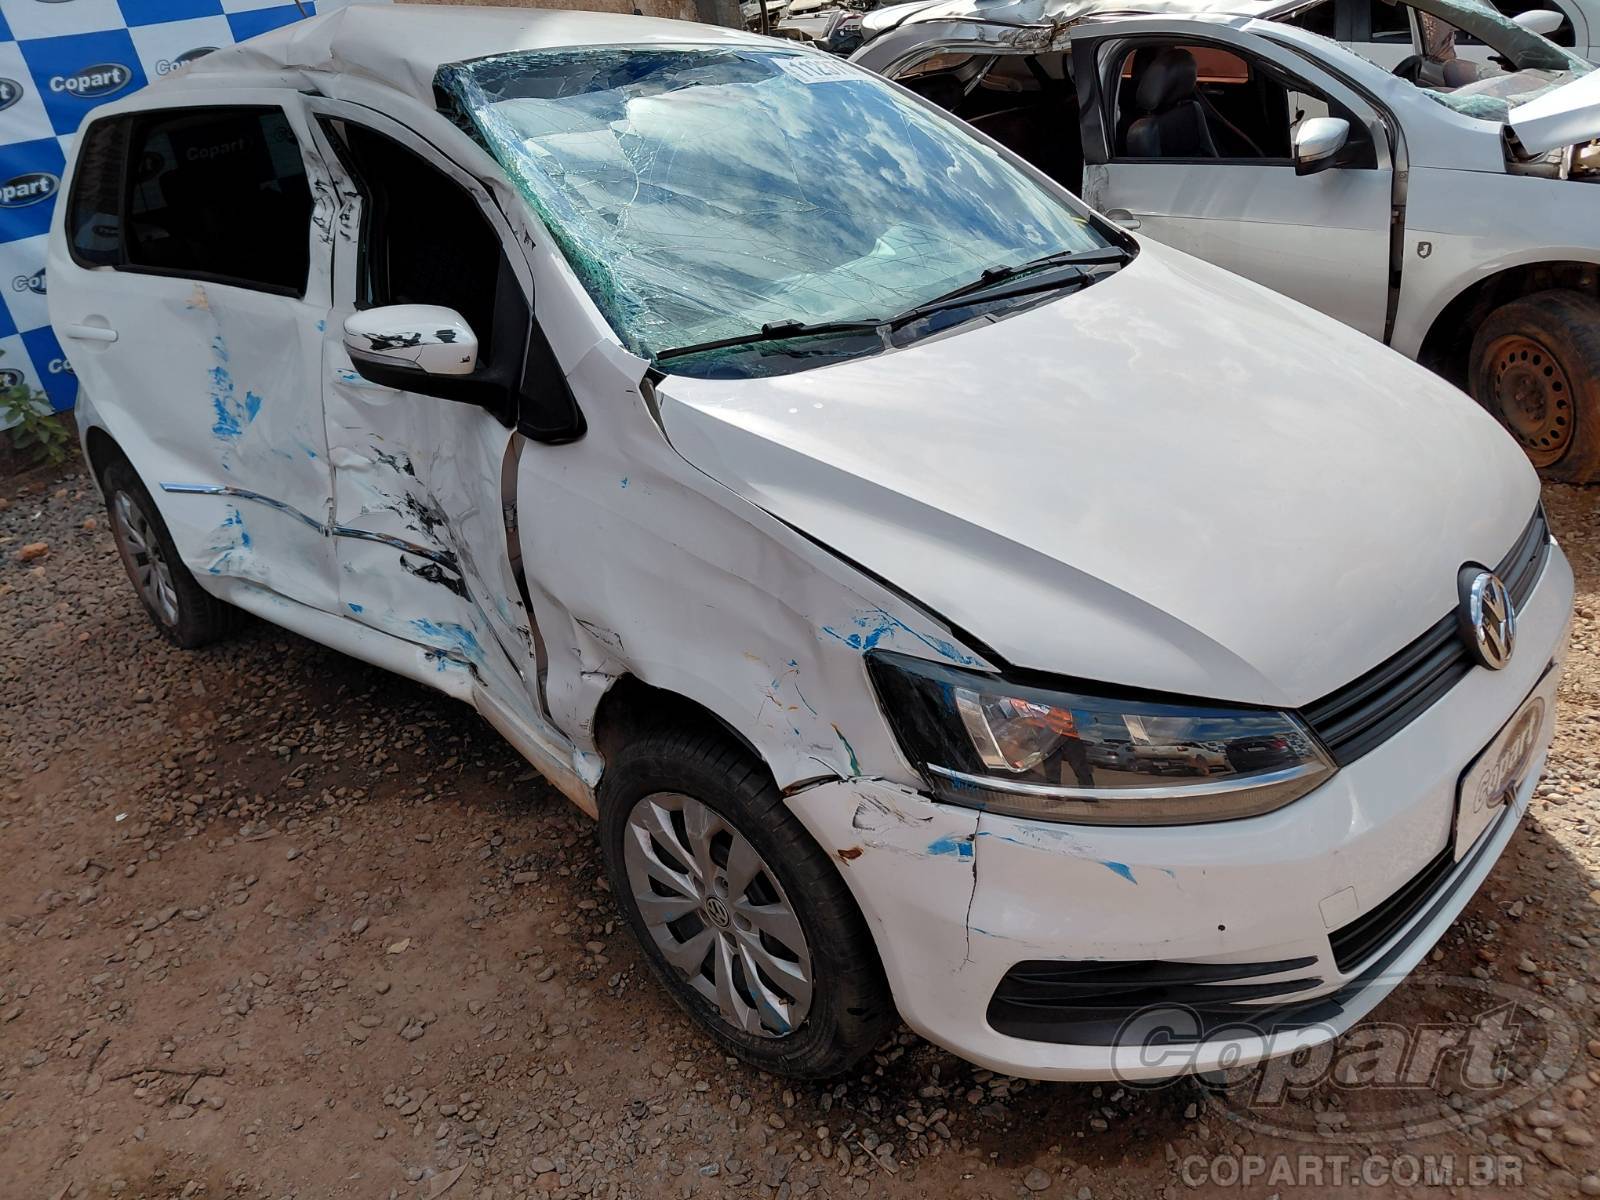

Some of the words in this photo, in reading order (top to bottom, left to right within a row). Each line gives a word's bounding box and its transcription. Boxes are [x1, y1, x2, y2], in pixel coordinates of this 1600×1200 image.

[50, 68, 121, 92] Copart
[186, 138, 246, 161] Copart
[0, 177, 49, 202] part
[1473, 706, 1534, 814] Copart
